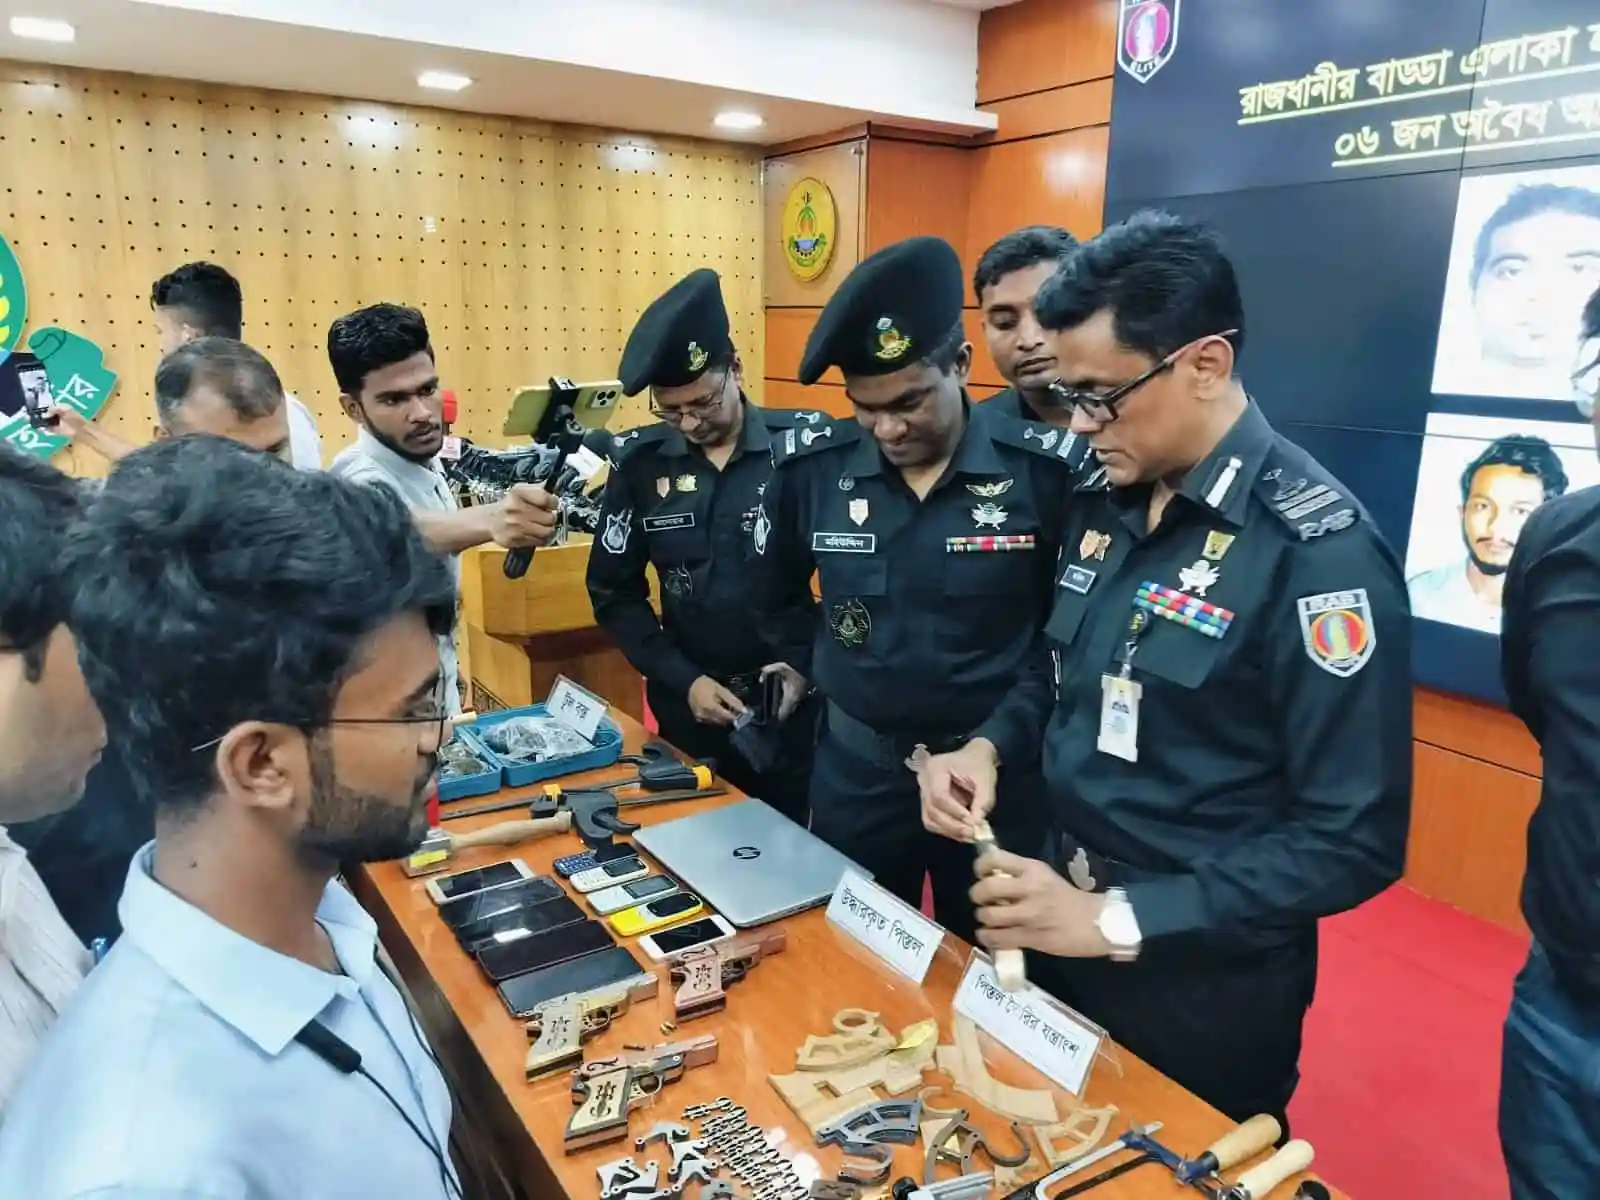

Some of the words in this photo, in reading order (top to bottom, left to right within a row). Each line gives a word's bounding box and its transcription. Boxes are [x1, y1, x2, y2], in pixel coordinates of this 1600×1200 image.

[1239, 61, 1361, 117] রাজধানীর
[1367, 48, 1454, 98] বাড্ডা
[1460, 24, 1580, 76] এলাকা
[1333, 125, 1383, 157] ০৬
[1391, 112, 1448, 152] জন
[841, 888, 888, 933] উদ্ধারকৃত
[889, 919, 925, 957] পিস্তল
[974, 974, 1005, 1005] পিস্তল
[1041, 1024, 1081, 1060] যন্ত্রাংশ
